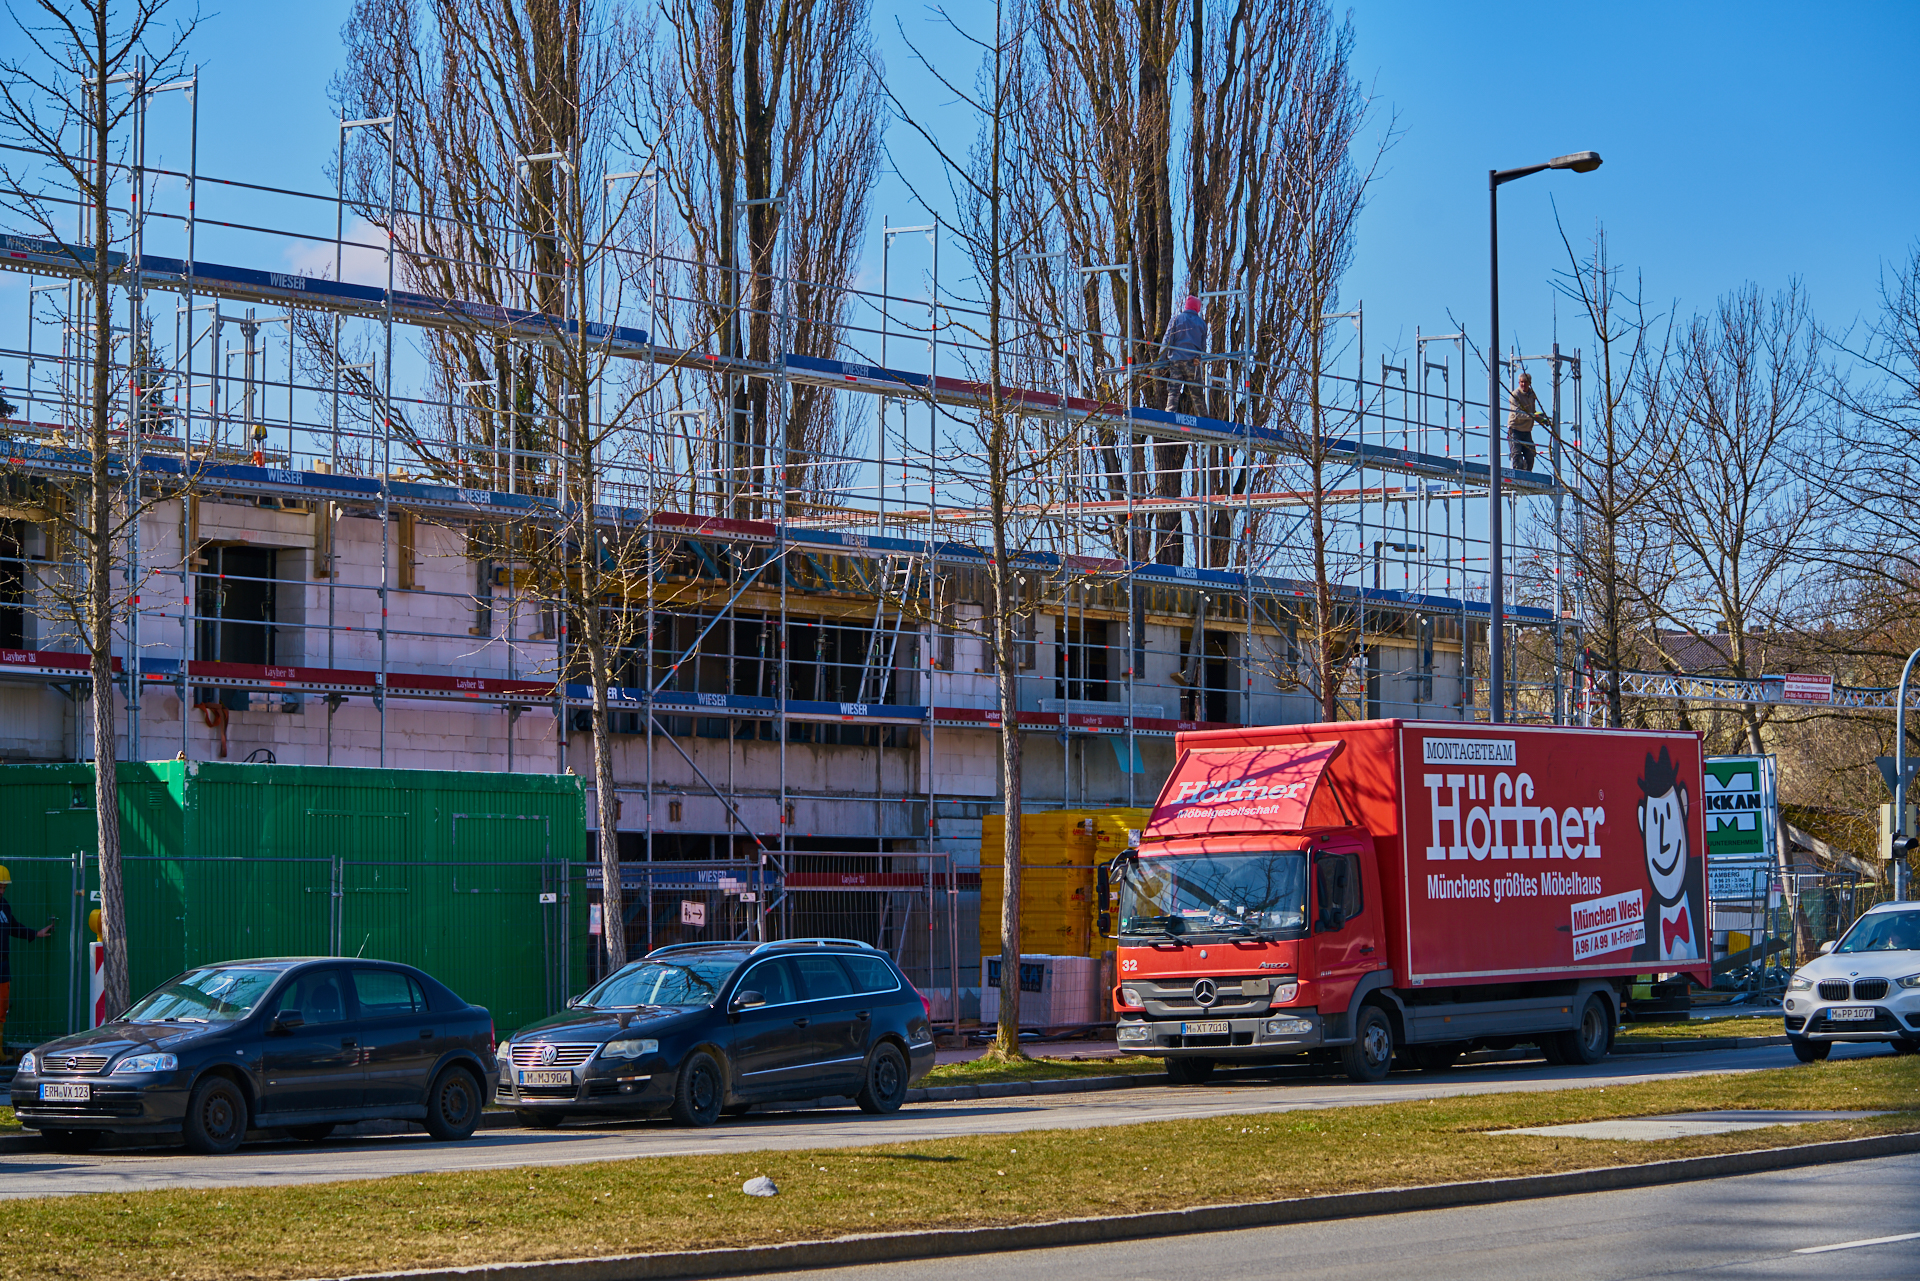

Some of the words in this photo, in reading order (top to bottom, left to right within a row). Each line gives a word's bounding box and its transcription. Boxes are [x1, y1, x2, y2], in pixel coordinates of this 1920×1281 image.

[269, 272, 306, 291] WIESER
[842, 362, 869, 377] WIESER
[1175, 412, 1197, 427] WIESER
[1400, 450, 1419, 462] WIESER
[267, 468, 303, 485] WIESER
[1501, 467, 1516, 478] IESER
[593, 503, 619, 518] IESER
[1175, 566, 1198, 579] WIESER
[3, 651, 26, 663] Layher
[264, 667, 286, 678] Layher
[456, 679, 477, 690] Layher
[697, 692, 727, 707] WIESER
[840, 702, 868, 716] WIESER
[984, 710, 1000, 721] Layher
[1082, 716, 1097, 726] Layher
[1177, 721, 1191, 731] Layher
[1426, 742, 1513, 761] MONTAGETEAM
[1170, 779, 1306, 805] Höffner
[1706, 793, 1761, 811] ICKAN
[1177, 805, 1280, 819] Möbelgesellschaft
[1423, 772, 1605, 861] Höffner
[1427, 873, 1491, 899] Münchens
[1493, 872, 1538, 903] größtes
[1541, 871, 1602, 896] Möbelhaus
[1573, 905, 1617, 931] München
[1618, 897, 1642, 921] West
[1611, 928, 1645, 946] M-Freiham
[1122, 959, 1138, 972] 32
[1832, 1009, 1837, 1018] M
[1842, 1009, 1852, 1018] PP
[1854, 1008, 1874, 1018] 1077
[1186, 1024, 1192, 1033] M
[1196, 1023, 1207, 1032] XT
[1208, 1022, 1228, 1032] 7018
[527, 1073, 533, 1083] M
[538, 1073, 550, 1083] MJ
[550, 1072, 567, 1083] 904
[44, 1085, 59, 1098] ERH
[62, 1086, 73, 1098] VX
[74, 1086, 89, 1098] 123
